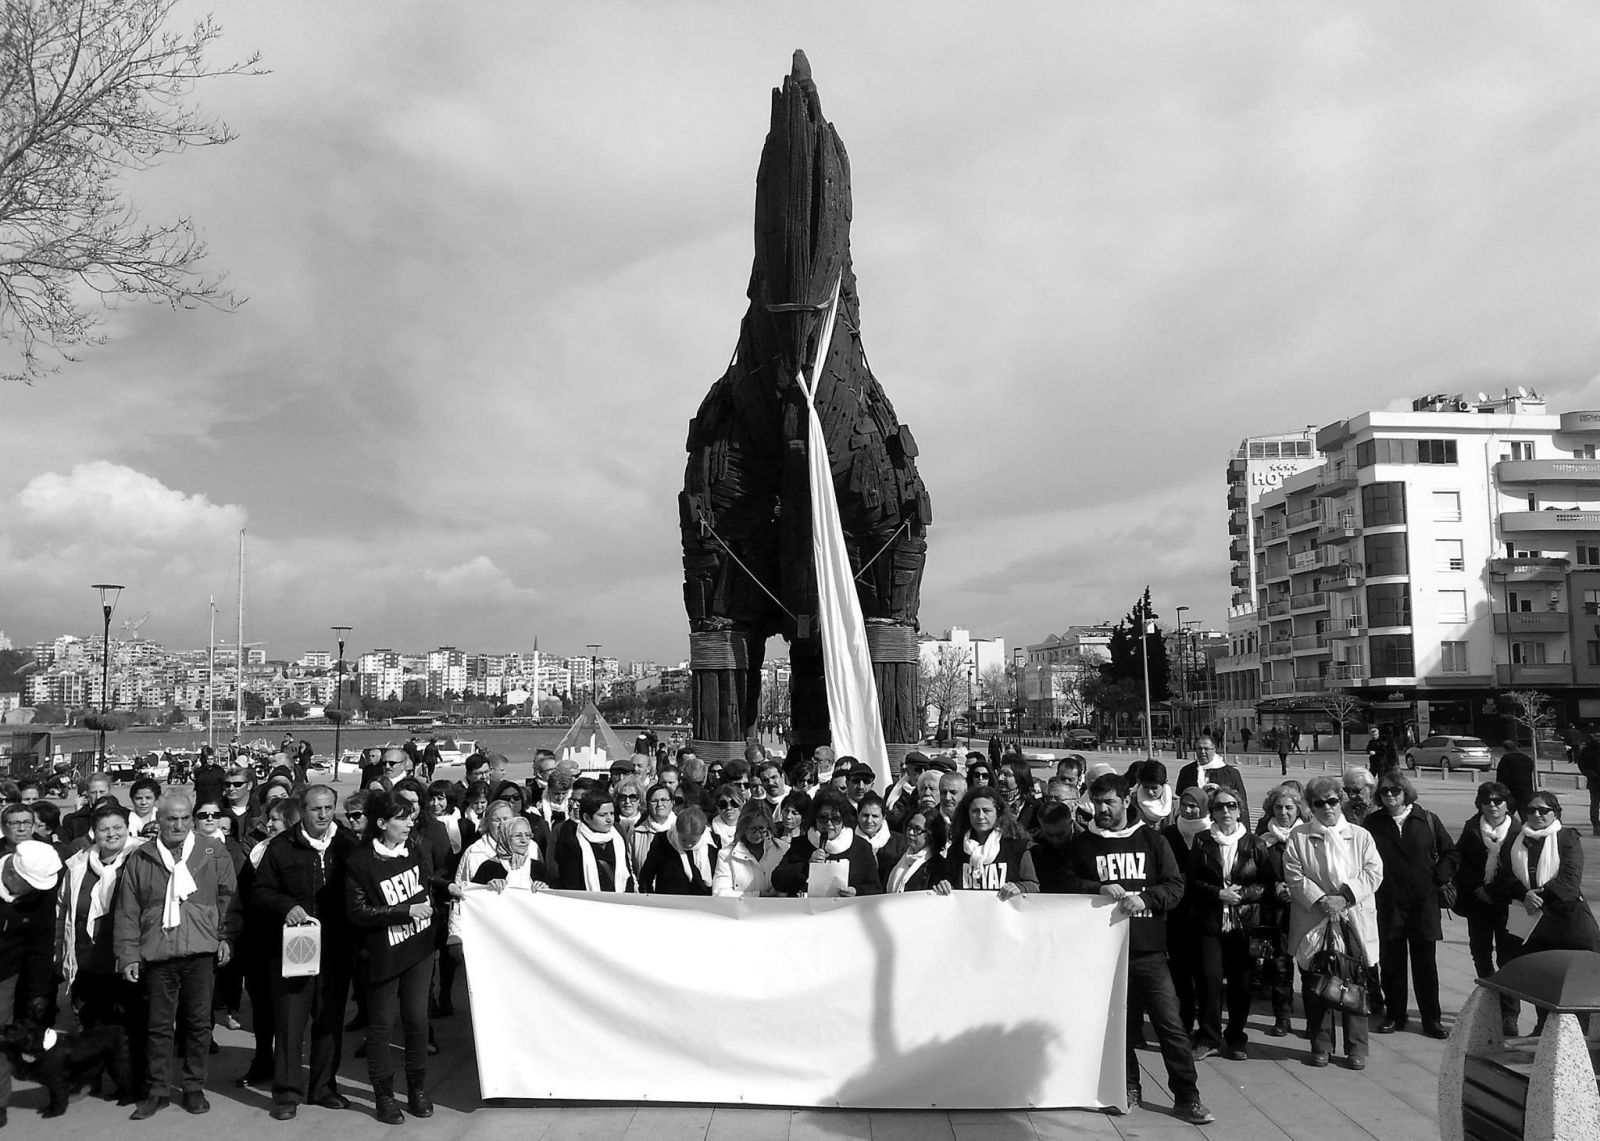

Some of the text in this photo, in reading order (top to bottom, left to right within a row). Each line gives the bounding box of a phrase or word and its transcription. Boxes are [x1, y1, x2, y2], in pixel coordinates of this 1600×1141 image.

[1252, 472, 1293, 486] HOT
[1096, 852, 1147, 882] BEYAZ
[380, 865, 424, 906] BEYAZ
